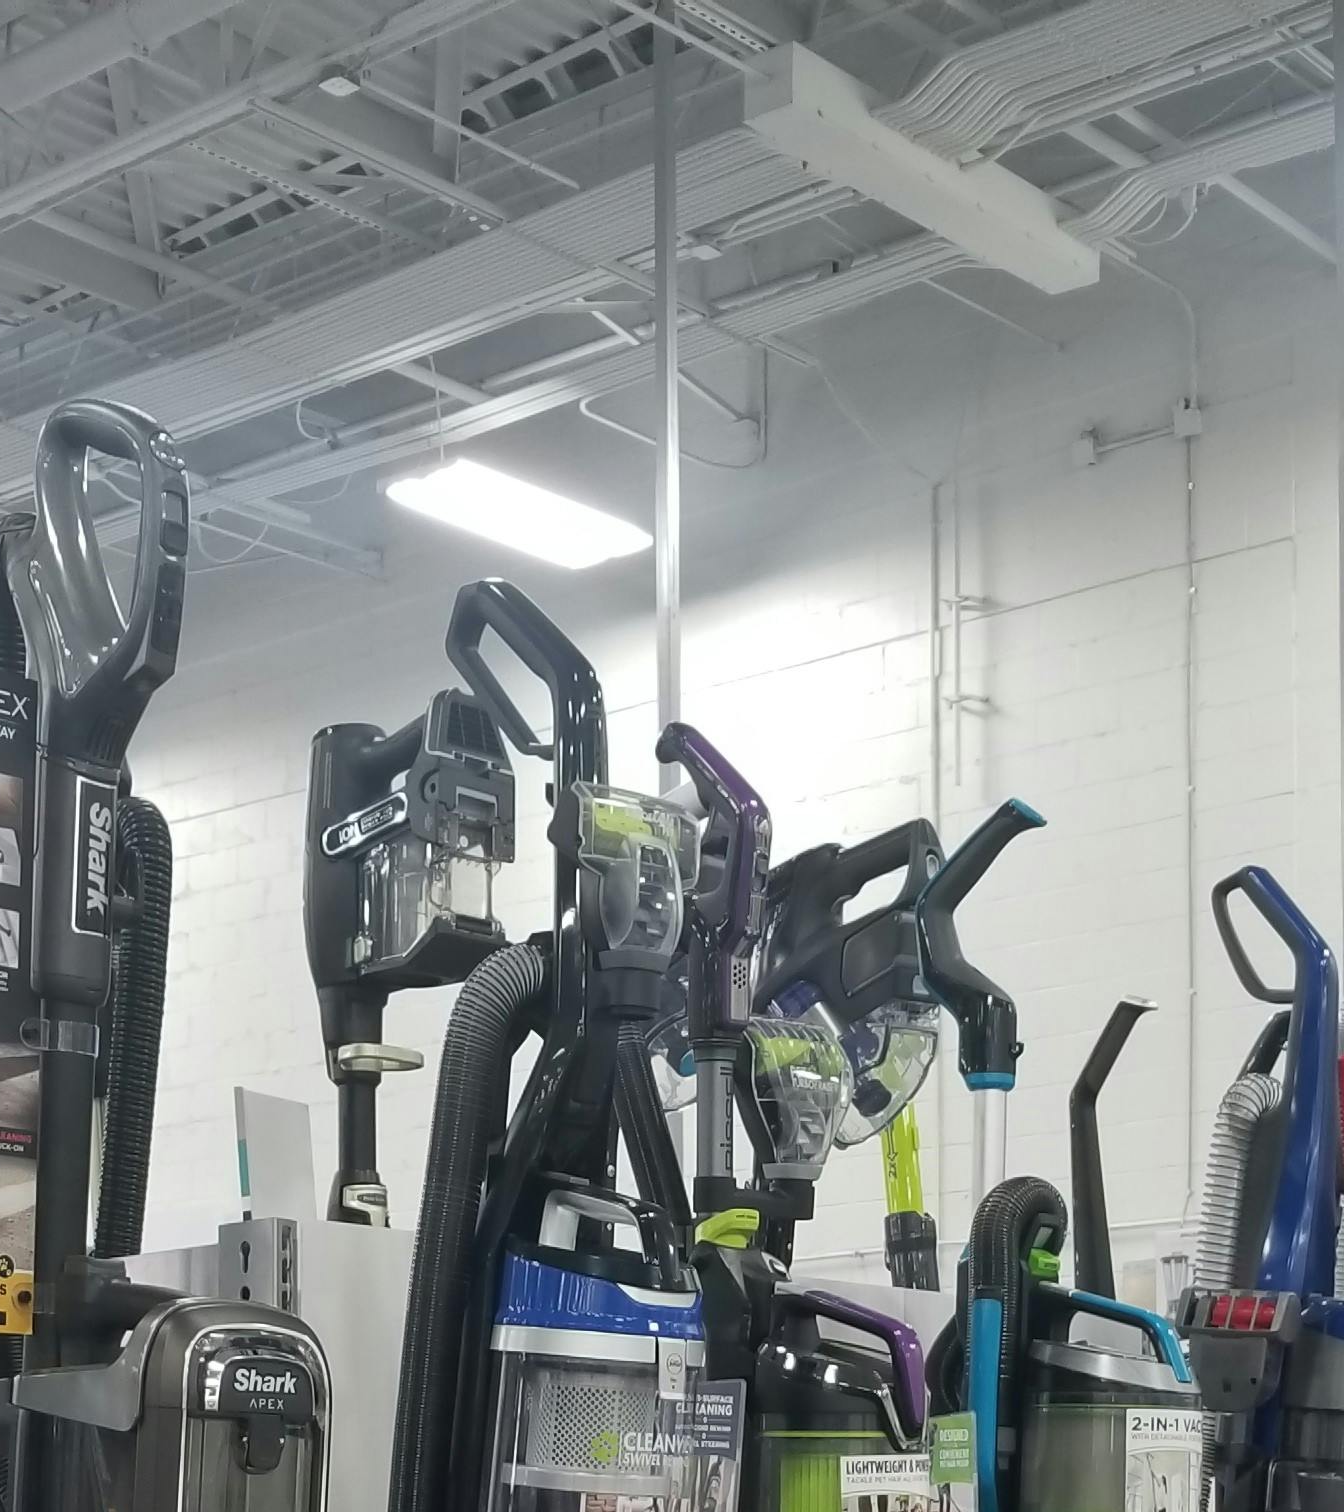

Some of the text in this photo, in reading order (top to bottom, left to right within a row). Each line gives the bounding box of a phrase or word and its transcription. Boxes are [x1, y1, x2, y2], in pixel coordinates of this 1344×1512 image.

[86, 802, 112, 917] Shark
[234, 1368, 297, 1394] Shark
[249, 1398, 285, 1410] APEX
[1131, 1415, 1180, 1432] 2-IN-1
